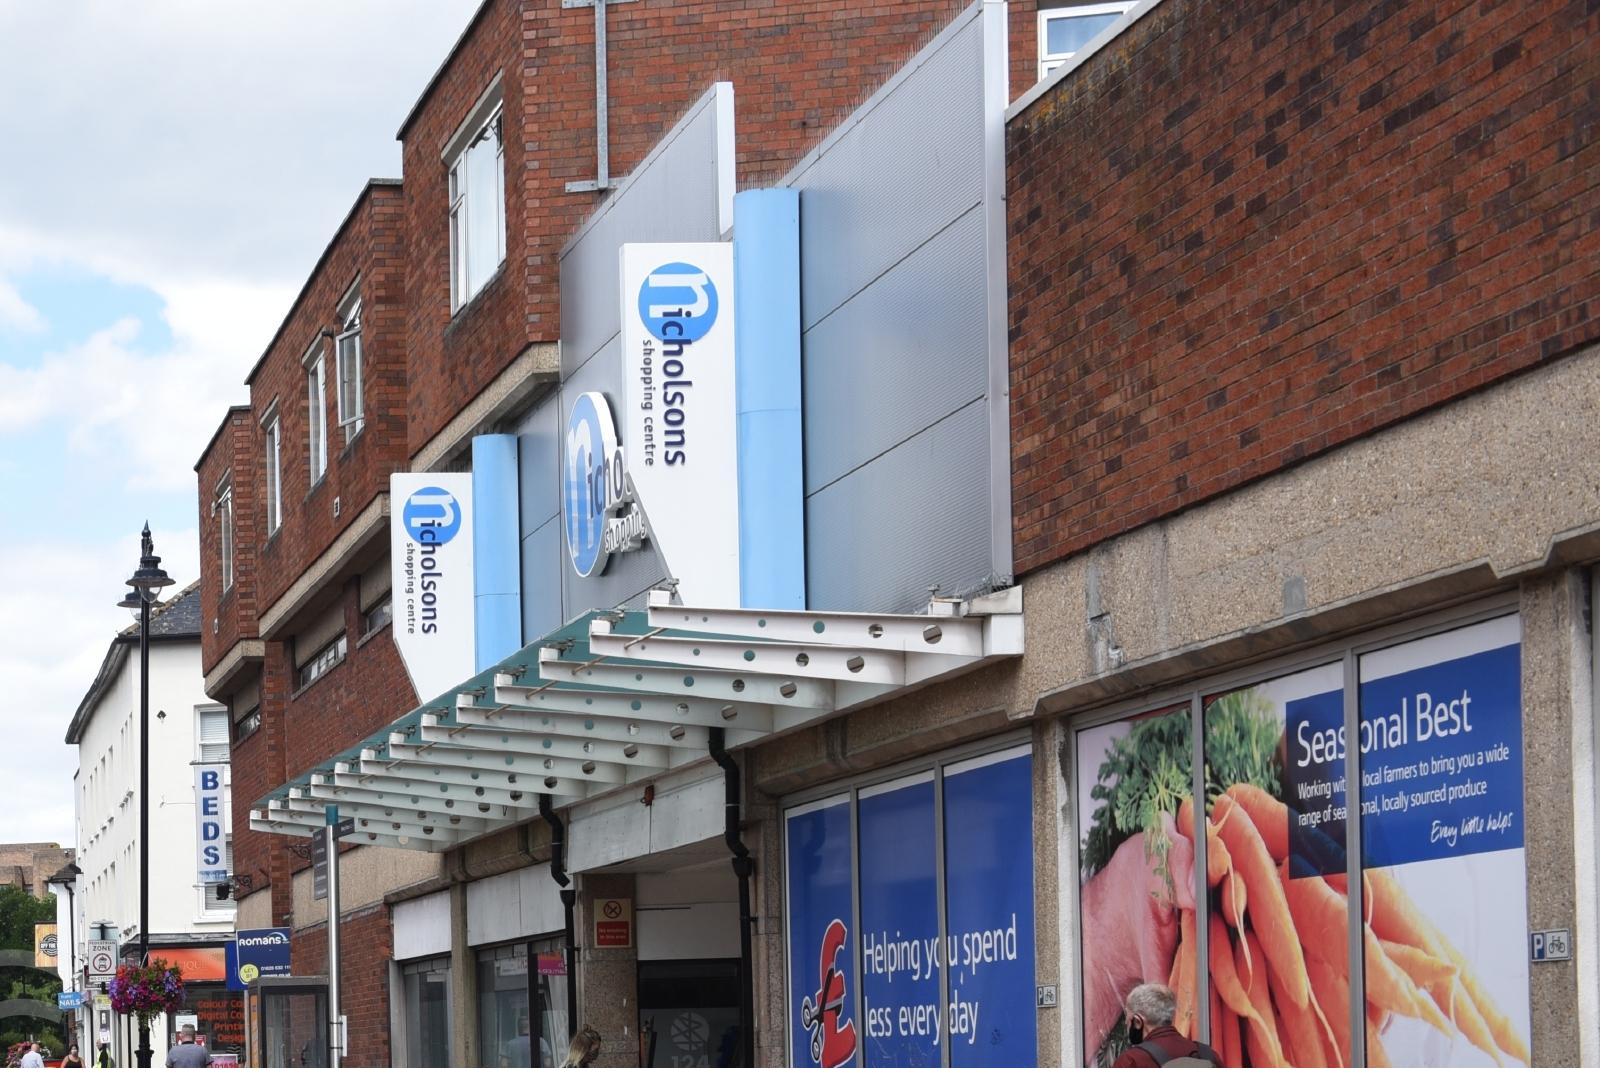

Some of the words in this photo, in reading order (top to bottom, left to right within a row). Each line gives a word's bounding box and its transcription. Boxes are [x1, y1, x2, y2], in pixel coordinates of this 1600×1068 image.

[640, 340, 656, 411] shopping
[648, 273, 709, 467] nicholsons
[643, 416, 654, 466] centre
[405, 542, 415, 594] shopping
[410, 494, 455, 635] nicholsons
[407, 598, 415, 635] centre
[1416, 689, 1473, 742] Best
[1297, 778, 1332, 800] Working
[1333, 775, 1347, 792] wit
[1362, 766, 1382, 788] local
[1383, 763, 1418, 783] farmers
[1419, 761, 1429, 775] to
[1431, 754, 1454, 776] bring
[1456, 752, 1476, 775] you
[1477, 752, 1484, 765] a
[1486, 742, 1510, 763] wide
[201, 770, 220, 866] BEDS
[1298, 810, 1322, 828] range
[1323, 804, 1332, 822] of
[1382, 791, 1410, 813] locally
[1411, 784, 1447, 807] sourced
[1449, 778, 1487, 804] produce
[1430, 819, 1458, 847] Every
[1461, 815, 1484, 836] little
[1487, 811, 1514, 834] helps
[864, 931, 920, 983] Helping
[963, 912, 1018, 976] spend
[59, 998, 81, 1007] NAILS
[865, 996, 892, 1038] less
